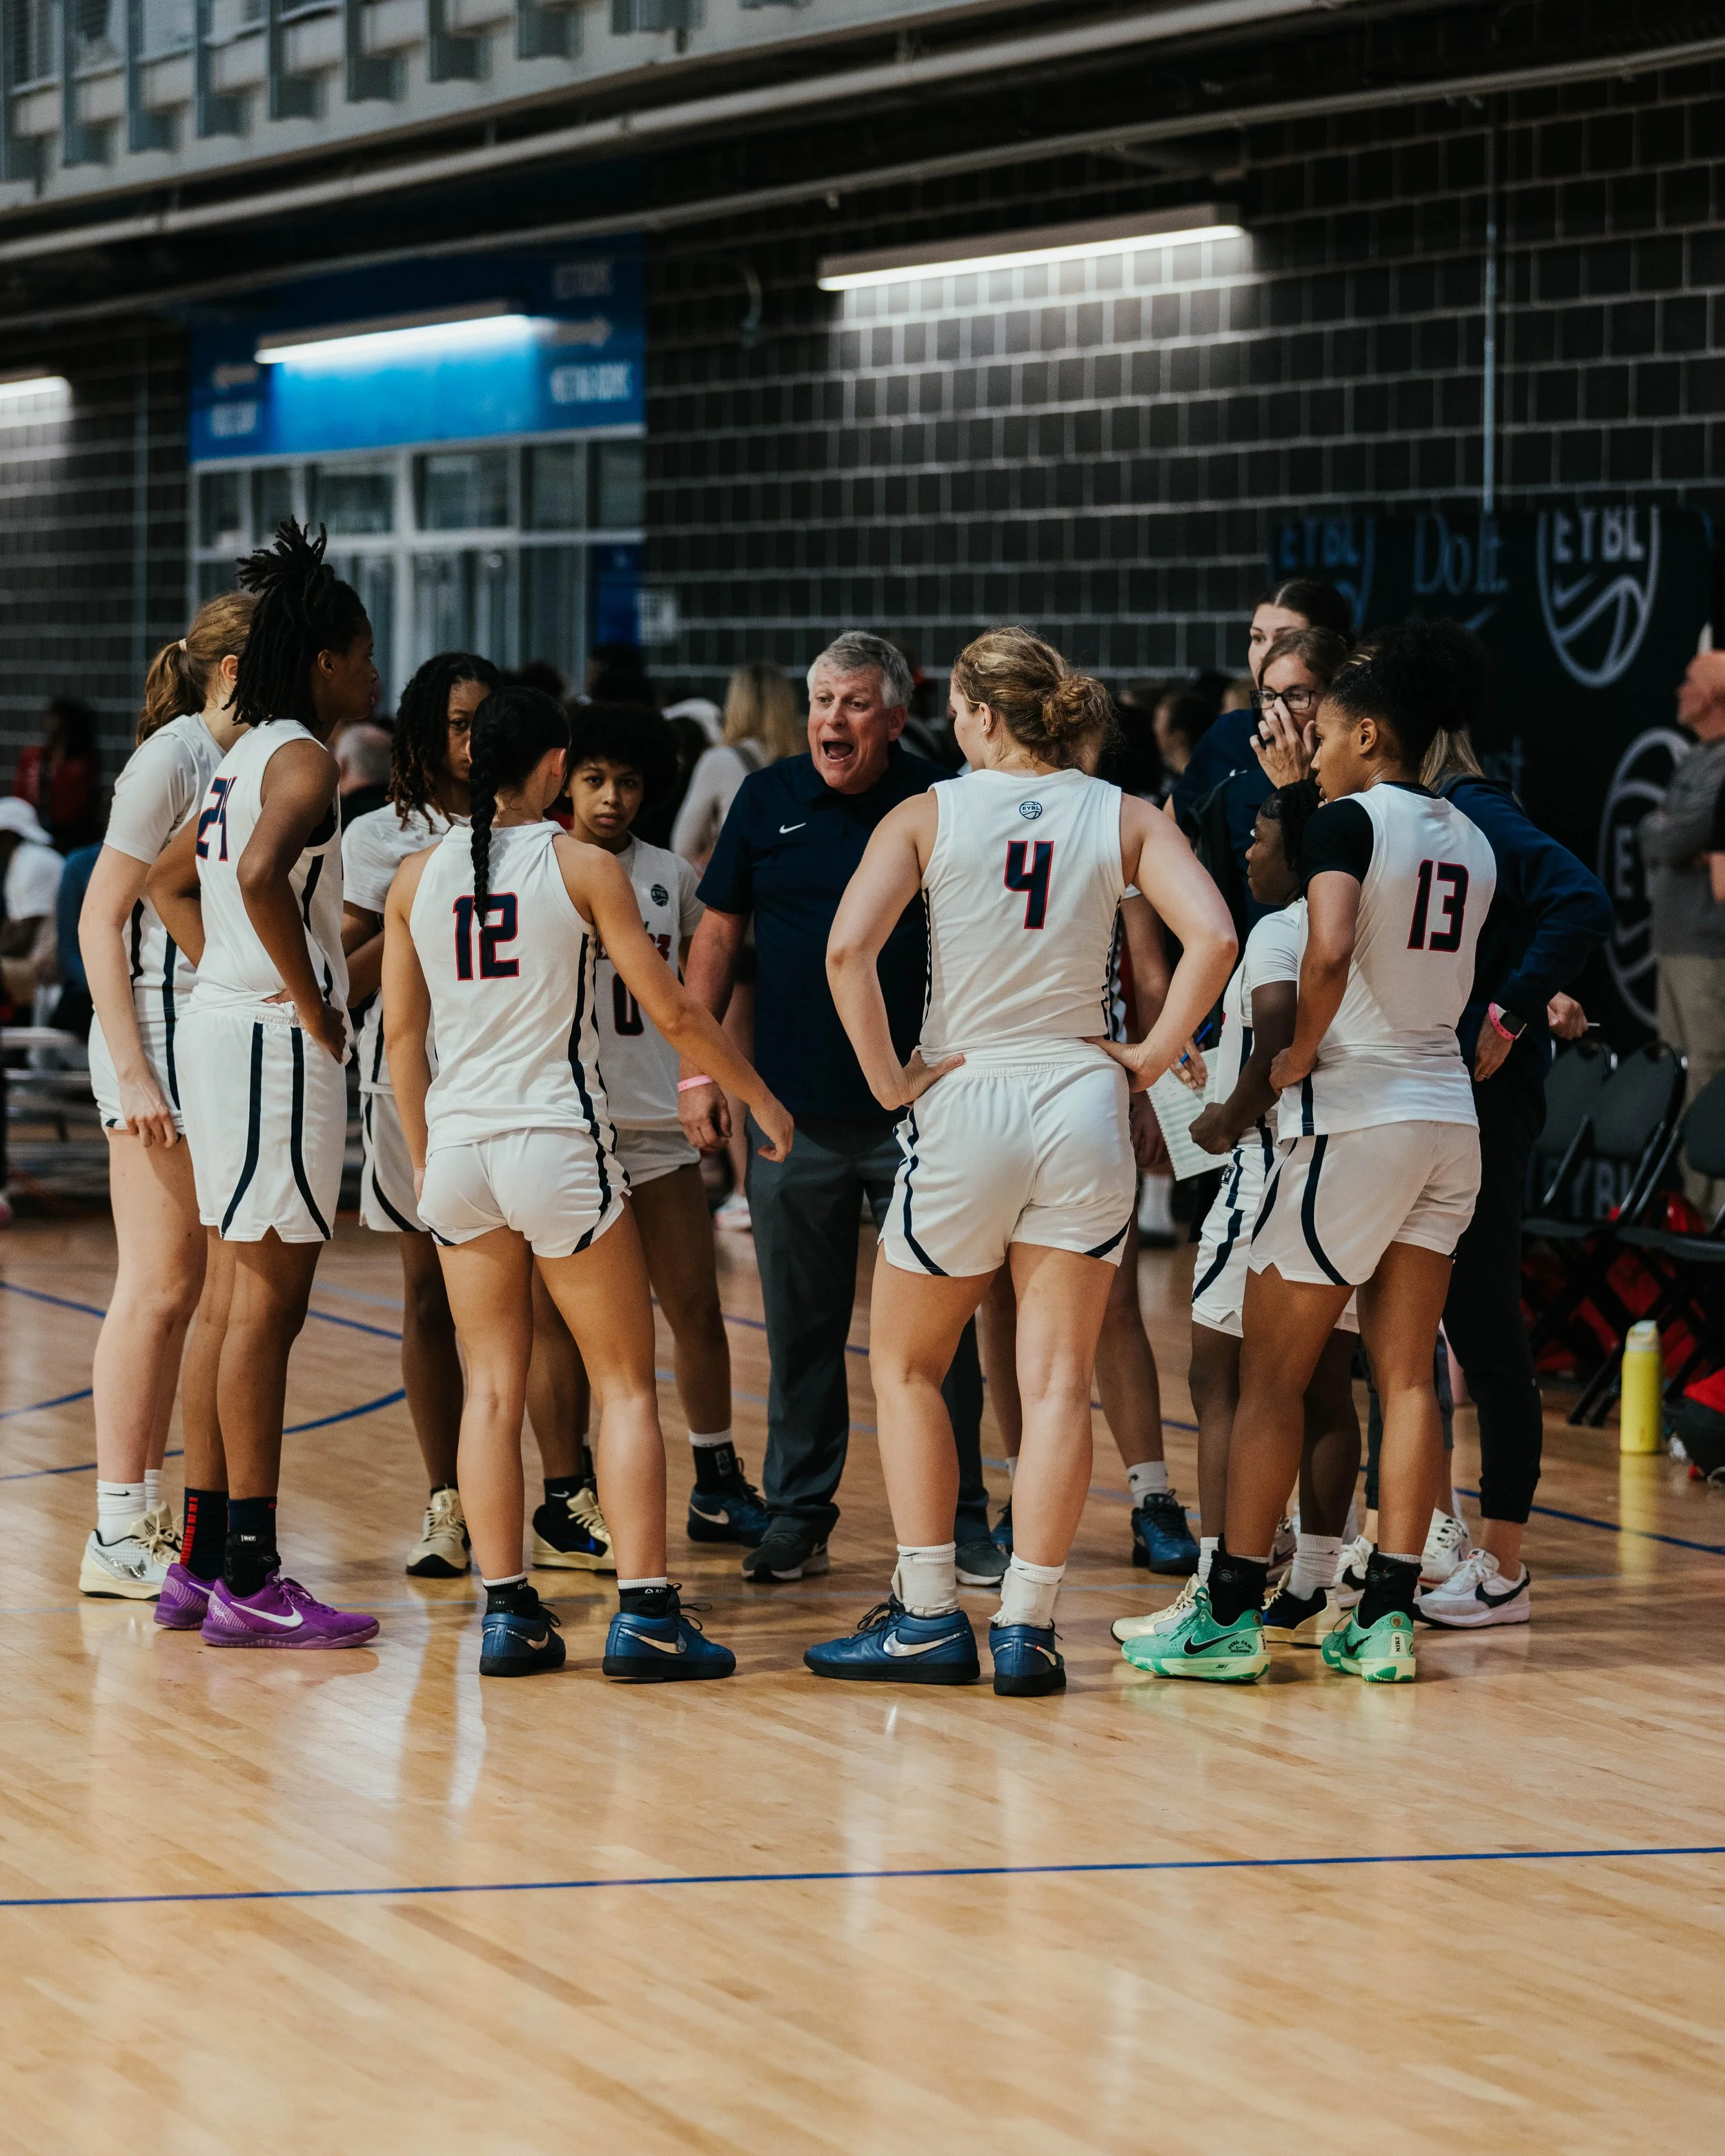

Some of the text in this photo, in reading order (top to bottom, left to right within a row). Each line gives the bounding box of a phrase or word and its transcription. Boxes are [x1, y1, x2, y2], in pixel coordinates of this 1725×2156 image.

[1412, 512, 1473, 595] Do
[1552, 505, 1646, 562] EYBL
[196, 776, 237, 861] 24
[1004, 840, 1054, 929] 4
[1407, 859, 1469, 953] 13
[453, 892, 519, 980] 12
[612, 971, 644, 1036] 0
